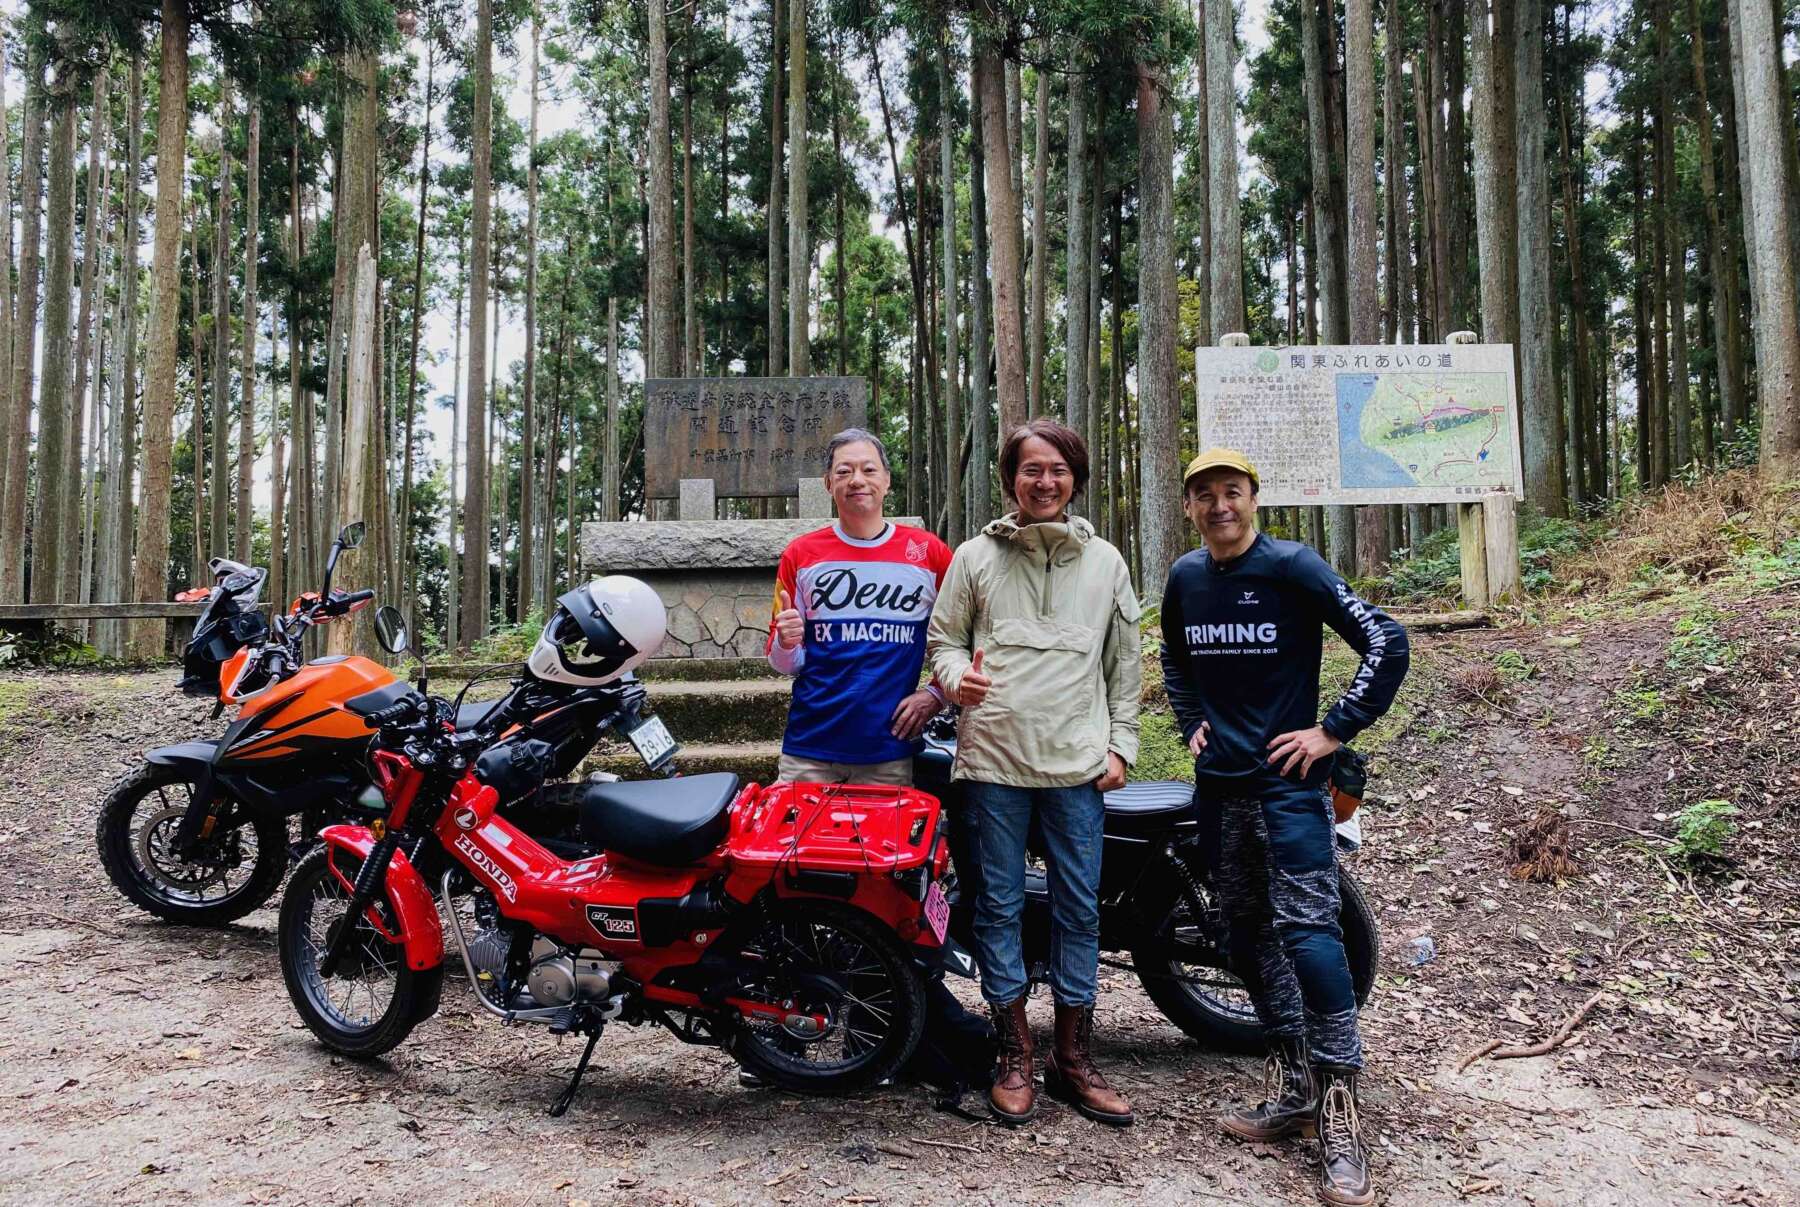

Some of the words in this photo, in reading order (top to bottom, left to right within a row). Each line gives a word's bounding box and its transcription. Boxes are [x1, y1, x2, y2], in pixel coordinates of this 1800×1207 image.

[1290, 353, 1453, 369] 関東ふれあいの道
[811, 567, 924, 613] Deus
[814, 623, 833, 642] EX
[1184, 622, 1278, 646] TRIMING
[454, 833, 518, 904] HONDA
[591, 911, 609, 921] CT
[604, 919, 635, 933] 125
